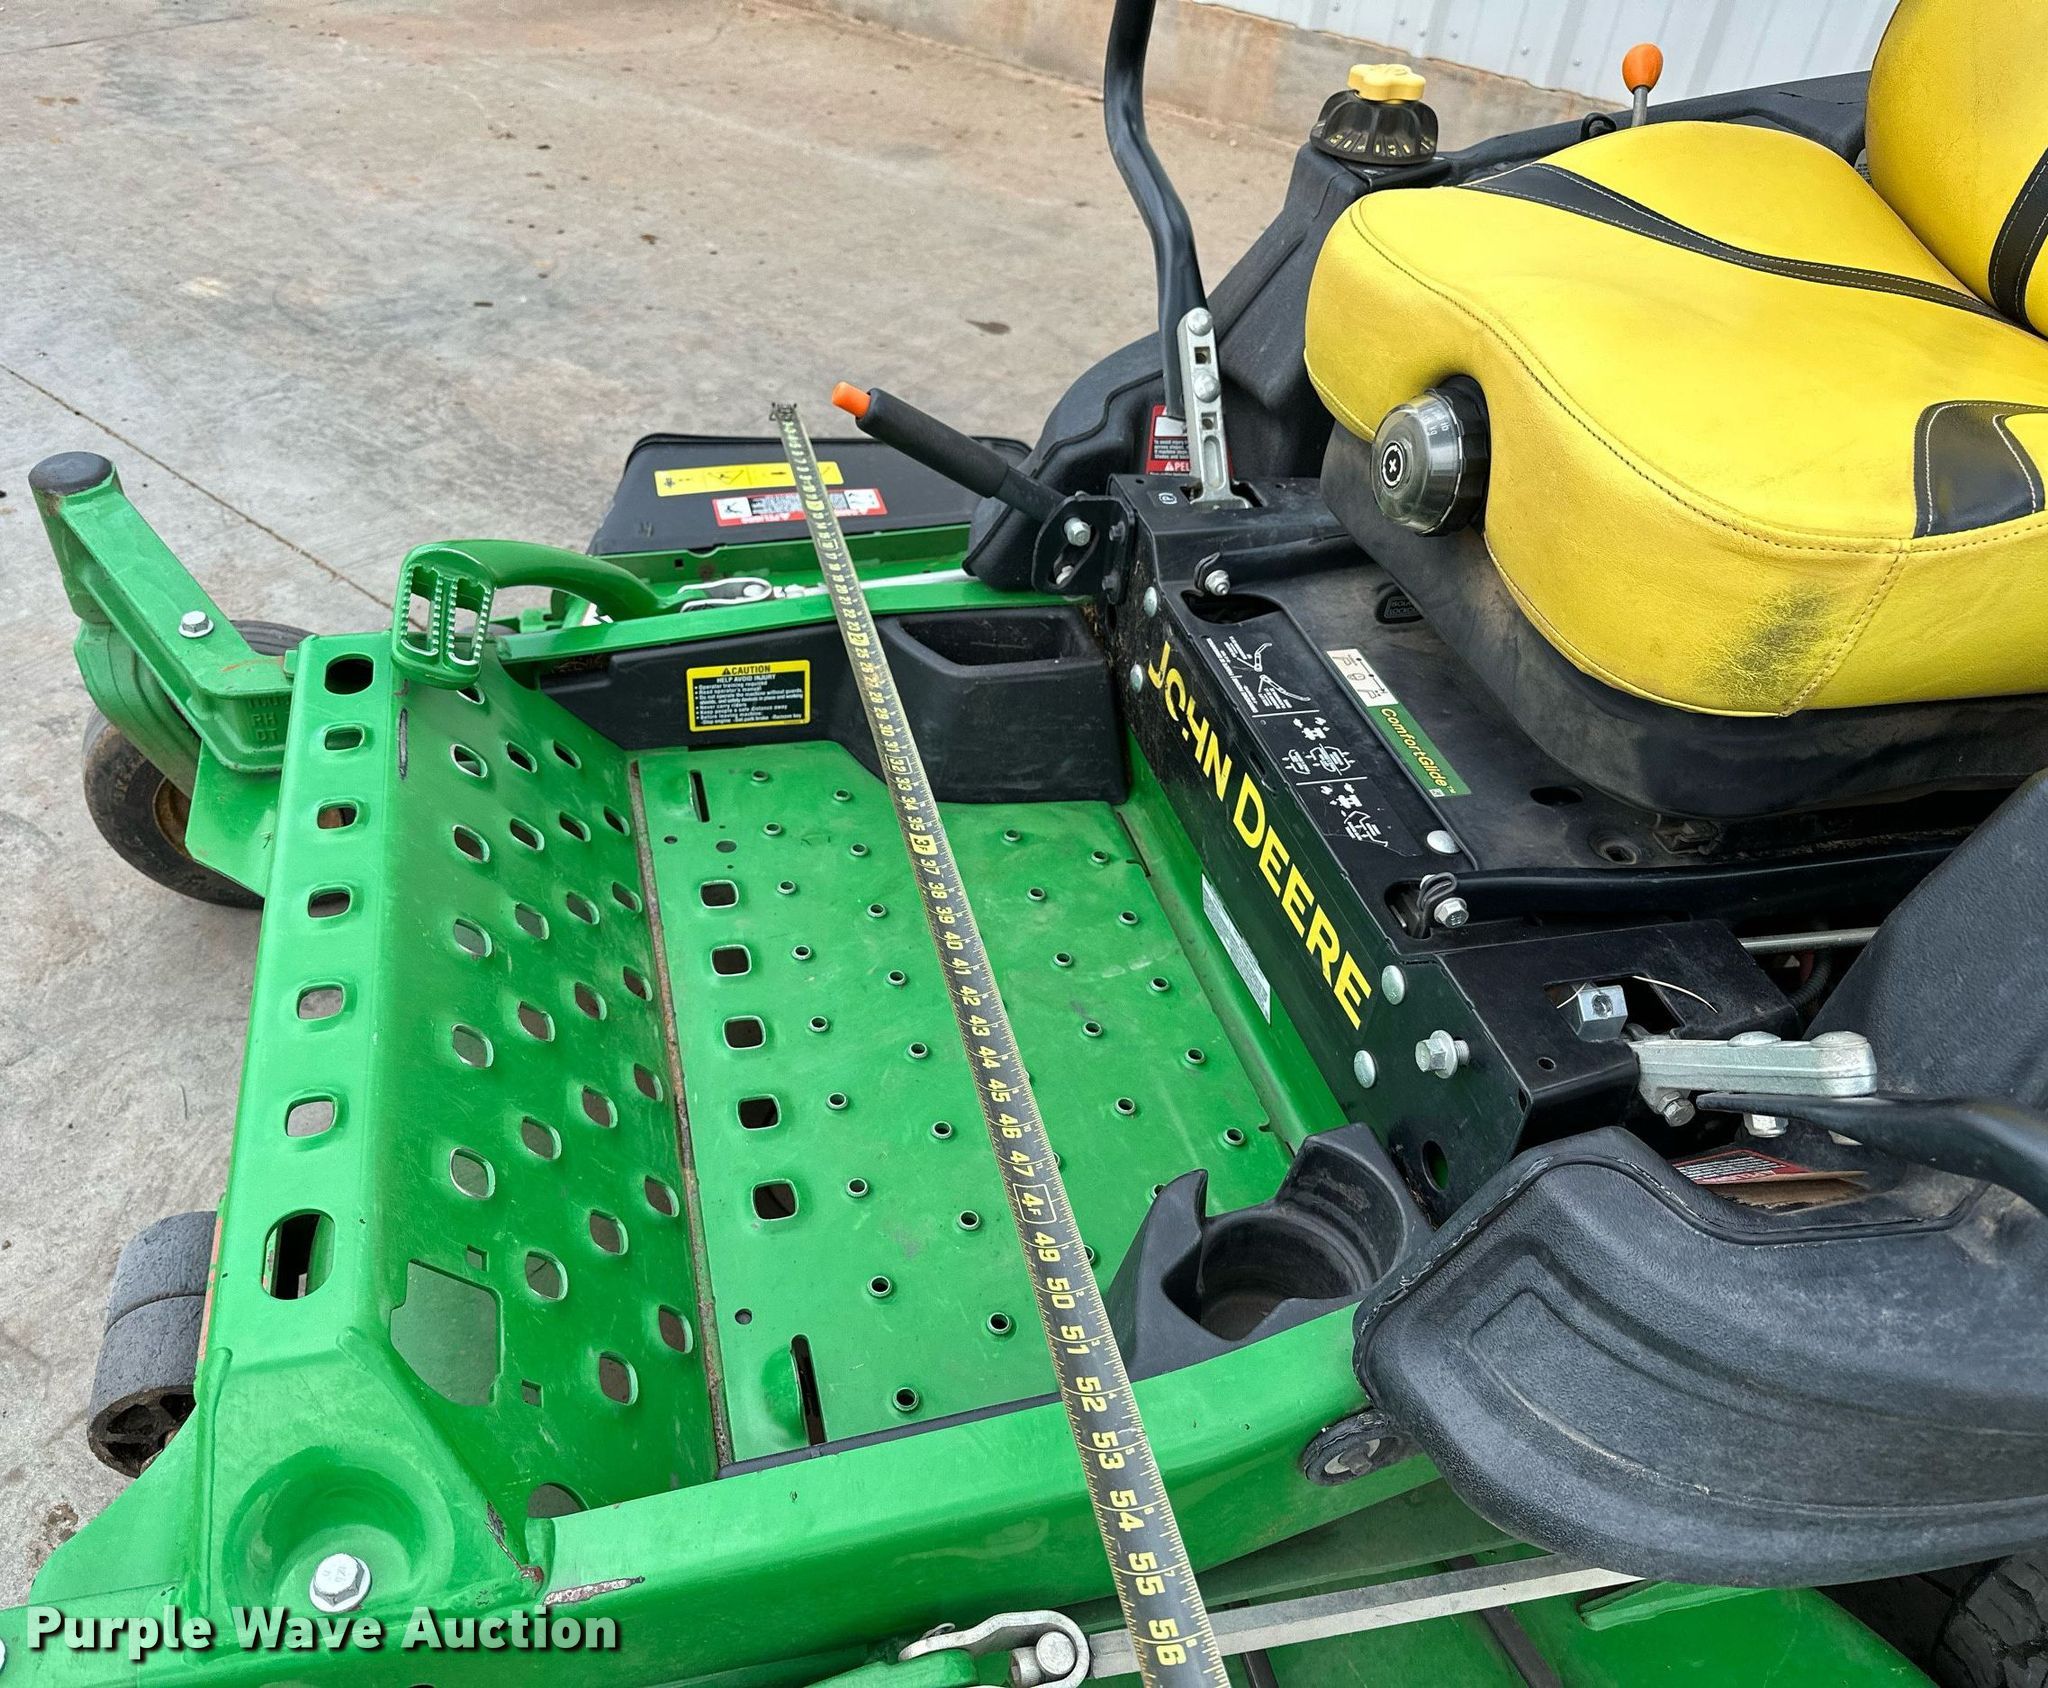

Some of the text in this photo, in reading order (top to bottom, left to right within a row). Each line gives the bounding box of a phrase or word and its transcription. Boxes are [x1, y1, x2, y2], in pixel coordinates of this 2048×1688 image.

[731, 665, 771, 675] CAUTION
[878, 723, 895, 737] 30
[889, 758, 907, 772] 32
[896, 777, 913, 791] 33
[901, 796, 919, 811] 34
[907, 816, 925, 831] 35
[1148, 640, 1232, 802] JOHN
[1232, 772, 1373, 1031] DEERE
[920, 859, 940, 875] 37
[928, 882, 948, 899] 38
[935, 906, 956, 924] 39
[943, 931, 964, 950] 40
[951, 957, 972, 975] 41
[959, 985, 981, 1007] 42
[969, 1014, 991, 1037] 43
[978, 1046, 1001, 1069] 44
[988, 1078, 1011, 1103] 45
[998, 1113, 1023, 1139] 46
[1009, 1150, 1035, 1177] 47
[1034, 1231, 1061, 1262] 49
[1046, 1277, 1076, 1310] 50
[1060, 1325, 1090, 1355] 51
[1075, 1376, 1108, 1412] 52
[1091, 1430, 1125, 1470] 53
[1109, 1489, 1145, 1532] 54
[1128, 1551, 1166, 1596] 55
[1148, 1617, 1187, 1667] 56
